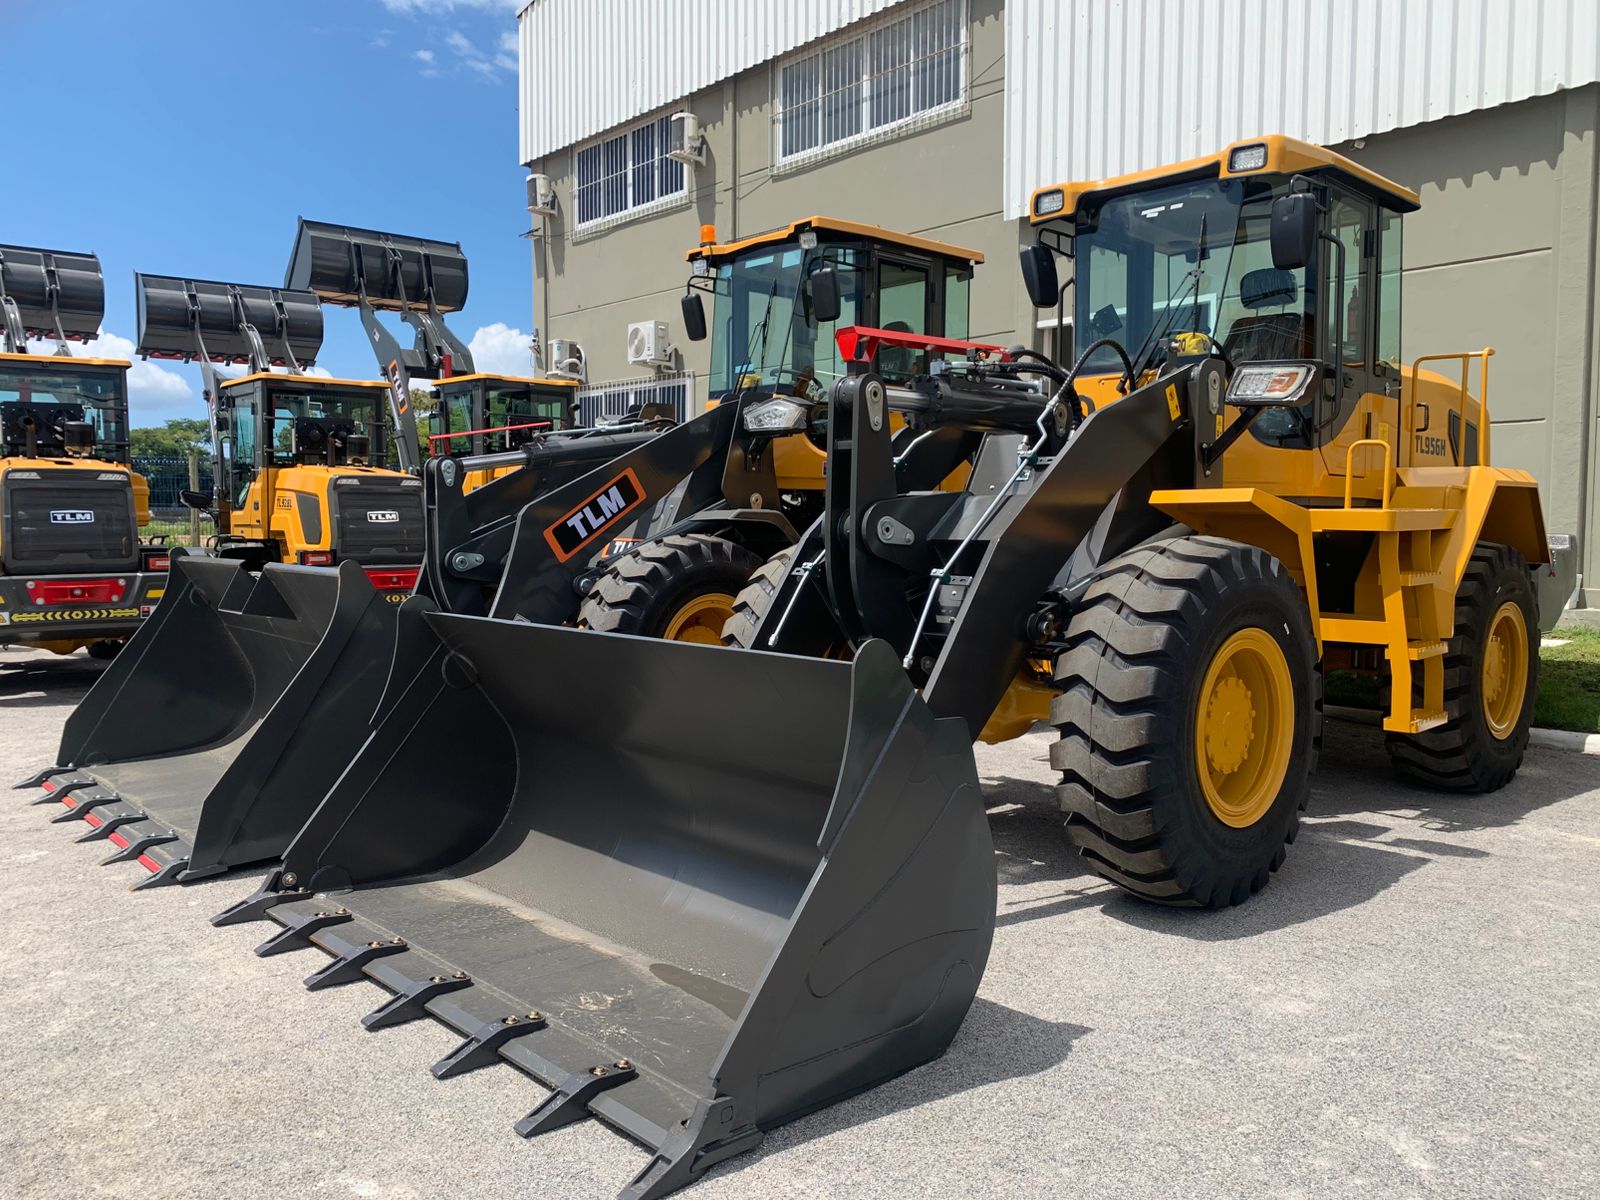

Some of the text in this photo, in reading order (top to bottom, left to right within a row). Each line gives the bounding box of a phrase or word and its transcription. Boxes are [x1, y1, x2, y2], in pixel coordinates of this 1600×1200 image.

[393, 371, 405, 401] TLM
[1416, 435, 1446, 457] TL956H
[54, 513, 92, 521] TLM
[370, 513, 397, 521] TLM
[567, 485, 626, 539] TLM
